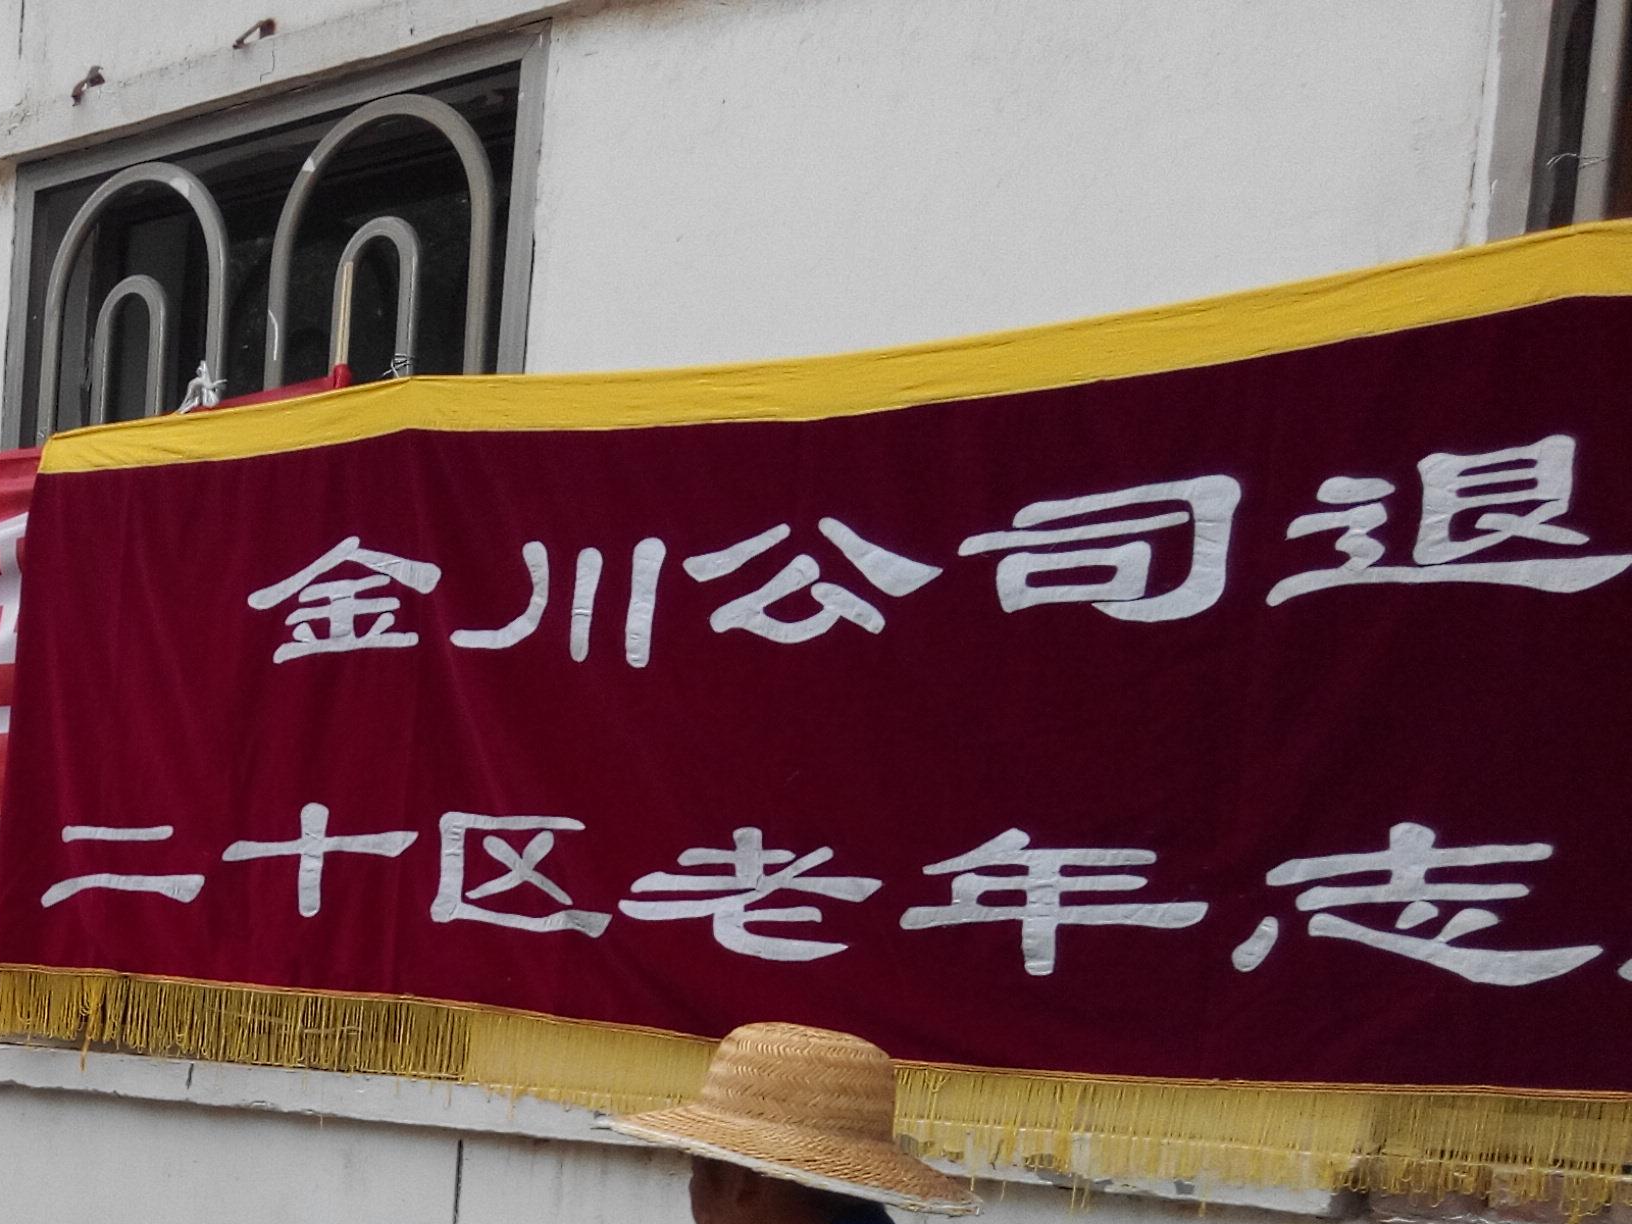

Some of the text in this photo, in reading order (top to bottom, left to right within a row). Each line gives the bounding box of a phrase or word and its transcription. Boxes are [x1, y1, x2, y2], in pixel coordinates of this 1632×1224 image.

[247, 434, 1632, 669] 金川公司退
[41, 803, 1632, 988] 二十区老年志
